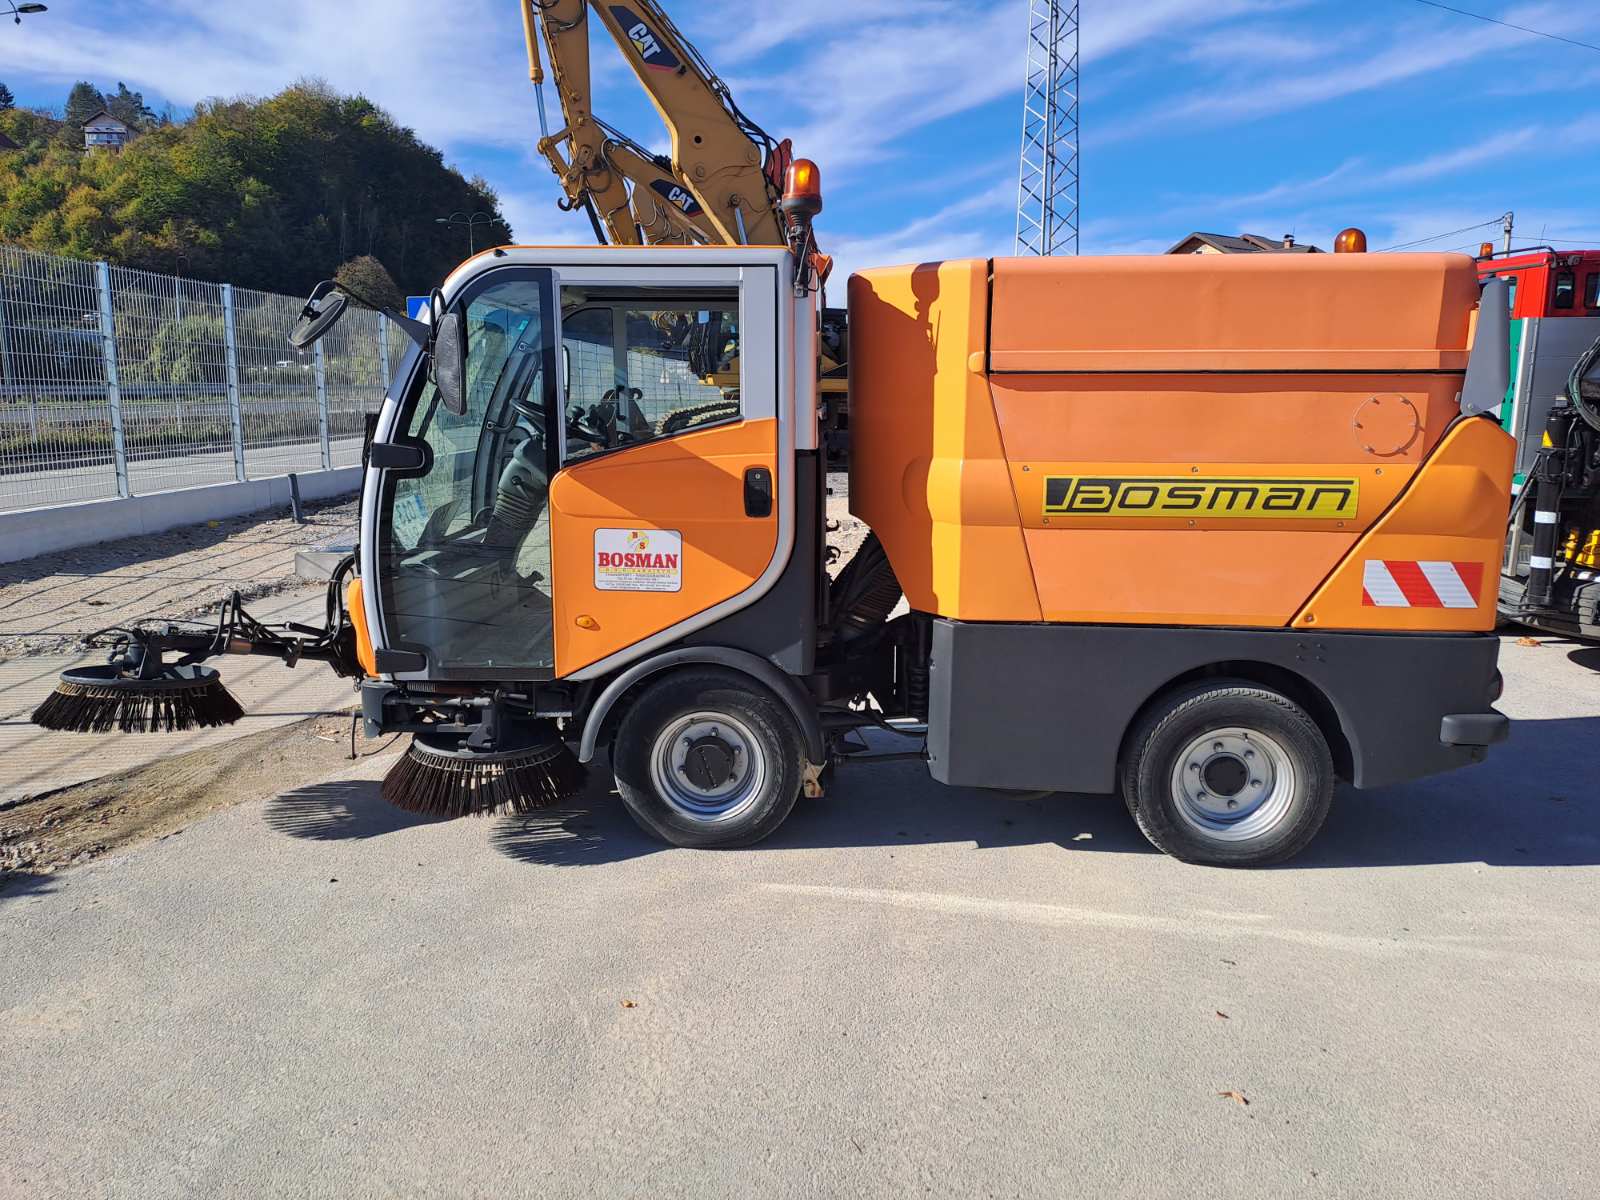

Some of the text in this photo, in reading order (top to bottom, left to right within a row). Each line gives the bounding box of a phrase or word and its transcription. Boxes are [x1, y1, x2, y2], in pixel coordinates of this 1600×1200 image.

[628, 22, 661, 59] CAT
[668, 186, 694, 212] CAT
[598, 552, 678, 569] BOSMAN
